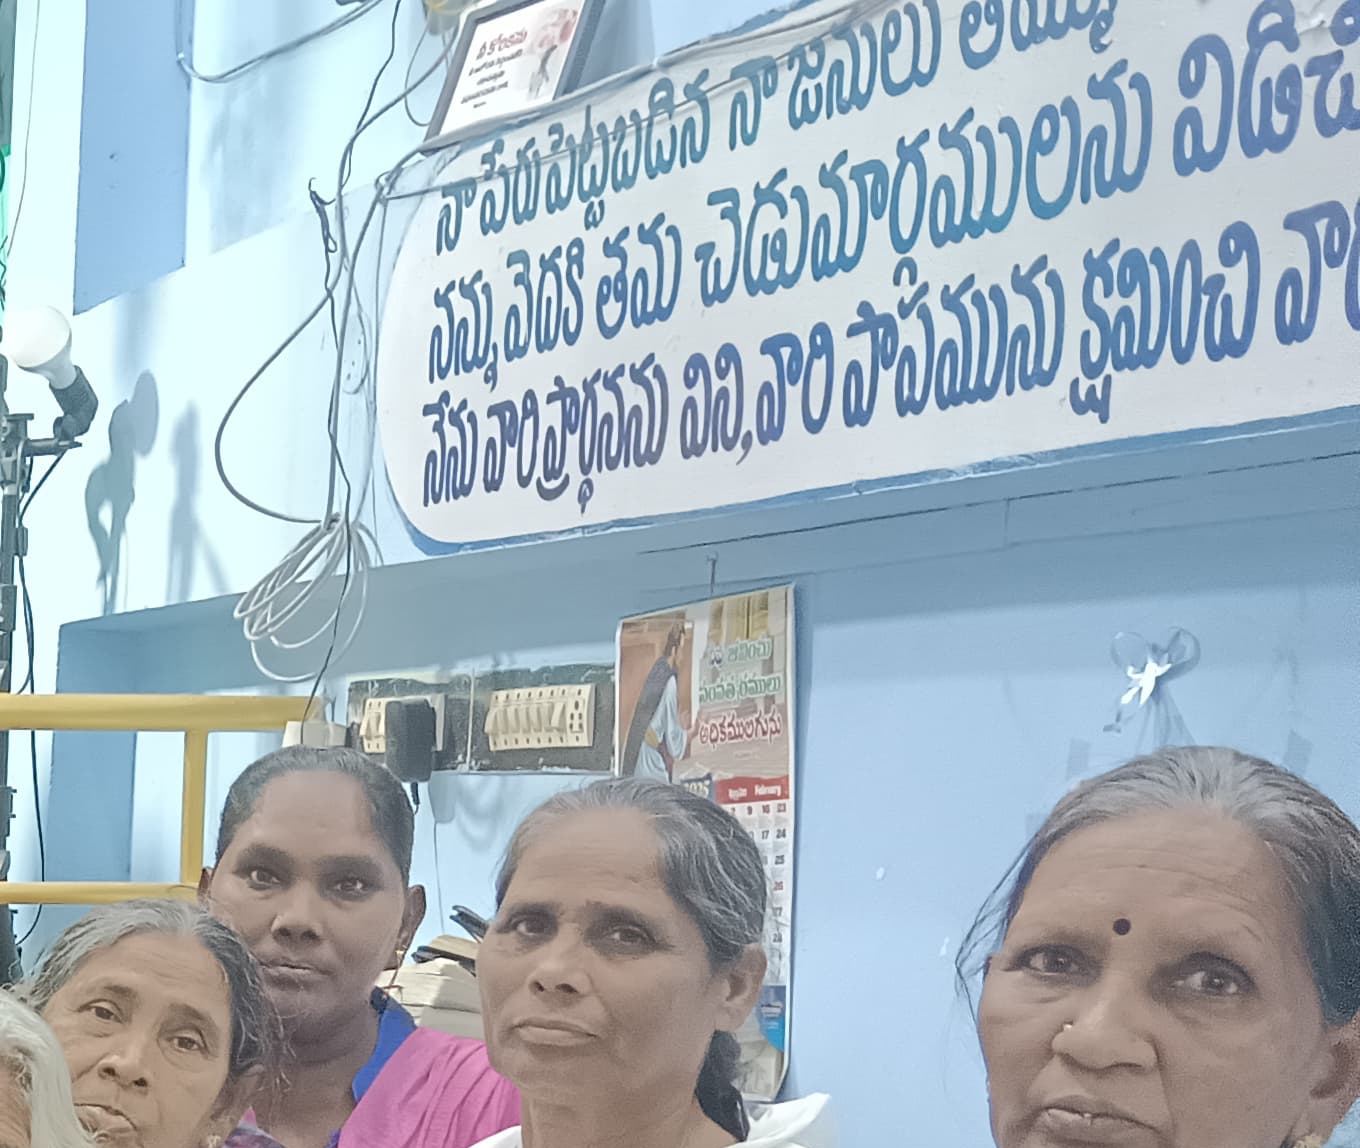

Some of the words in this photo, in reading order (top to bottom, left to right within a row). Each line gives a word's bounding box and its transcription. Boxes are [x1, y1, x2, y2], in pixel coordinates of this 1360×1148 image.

[729, 55, 778, 150] నా
[596, 212, 681, 339] తమ
[422, 390, 477, 507] నేను
[483, 388, 539, 493] వారి
[756, 321, 834, 445] వారి
